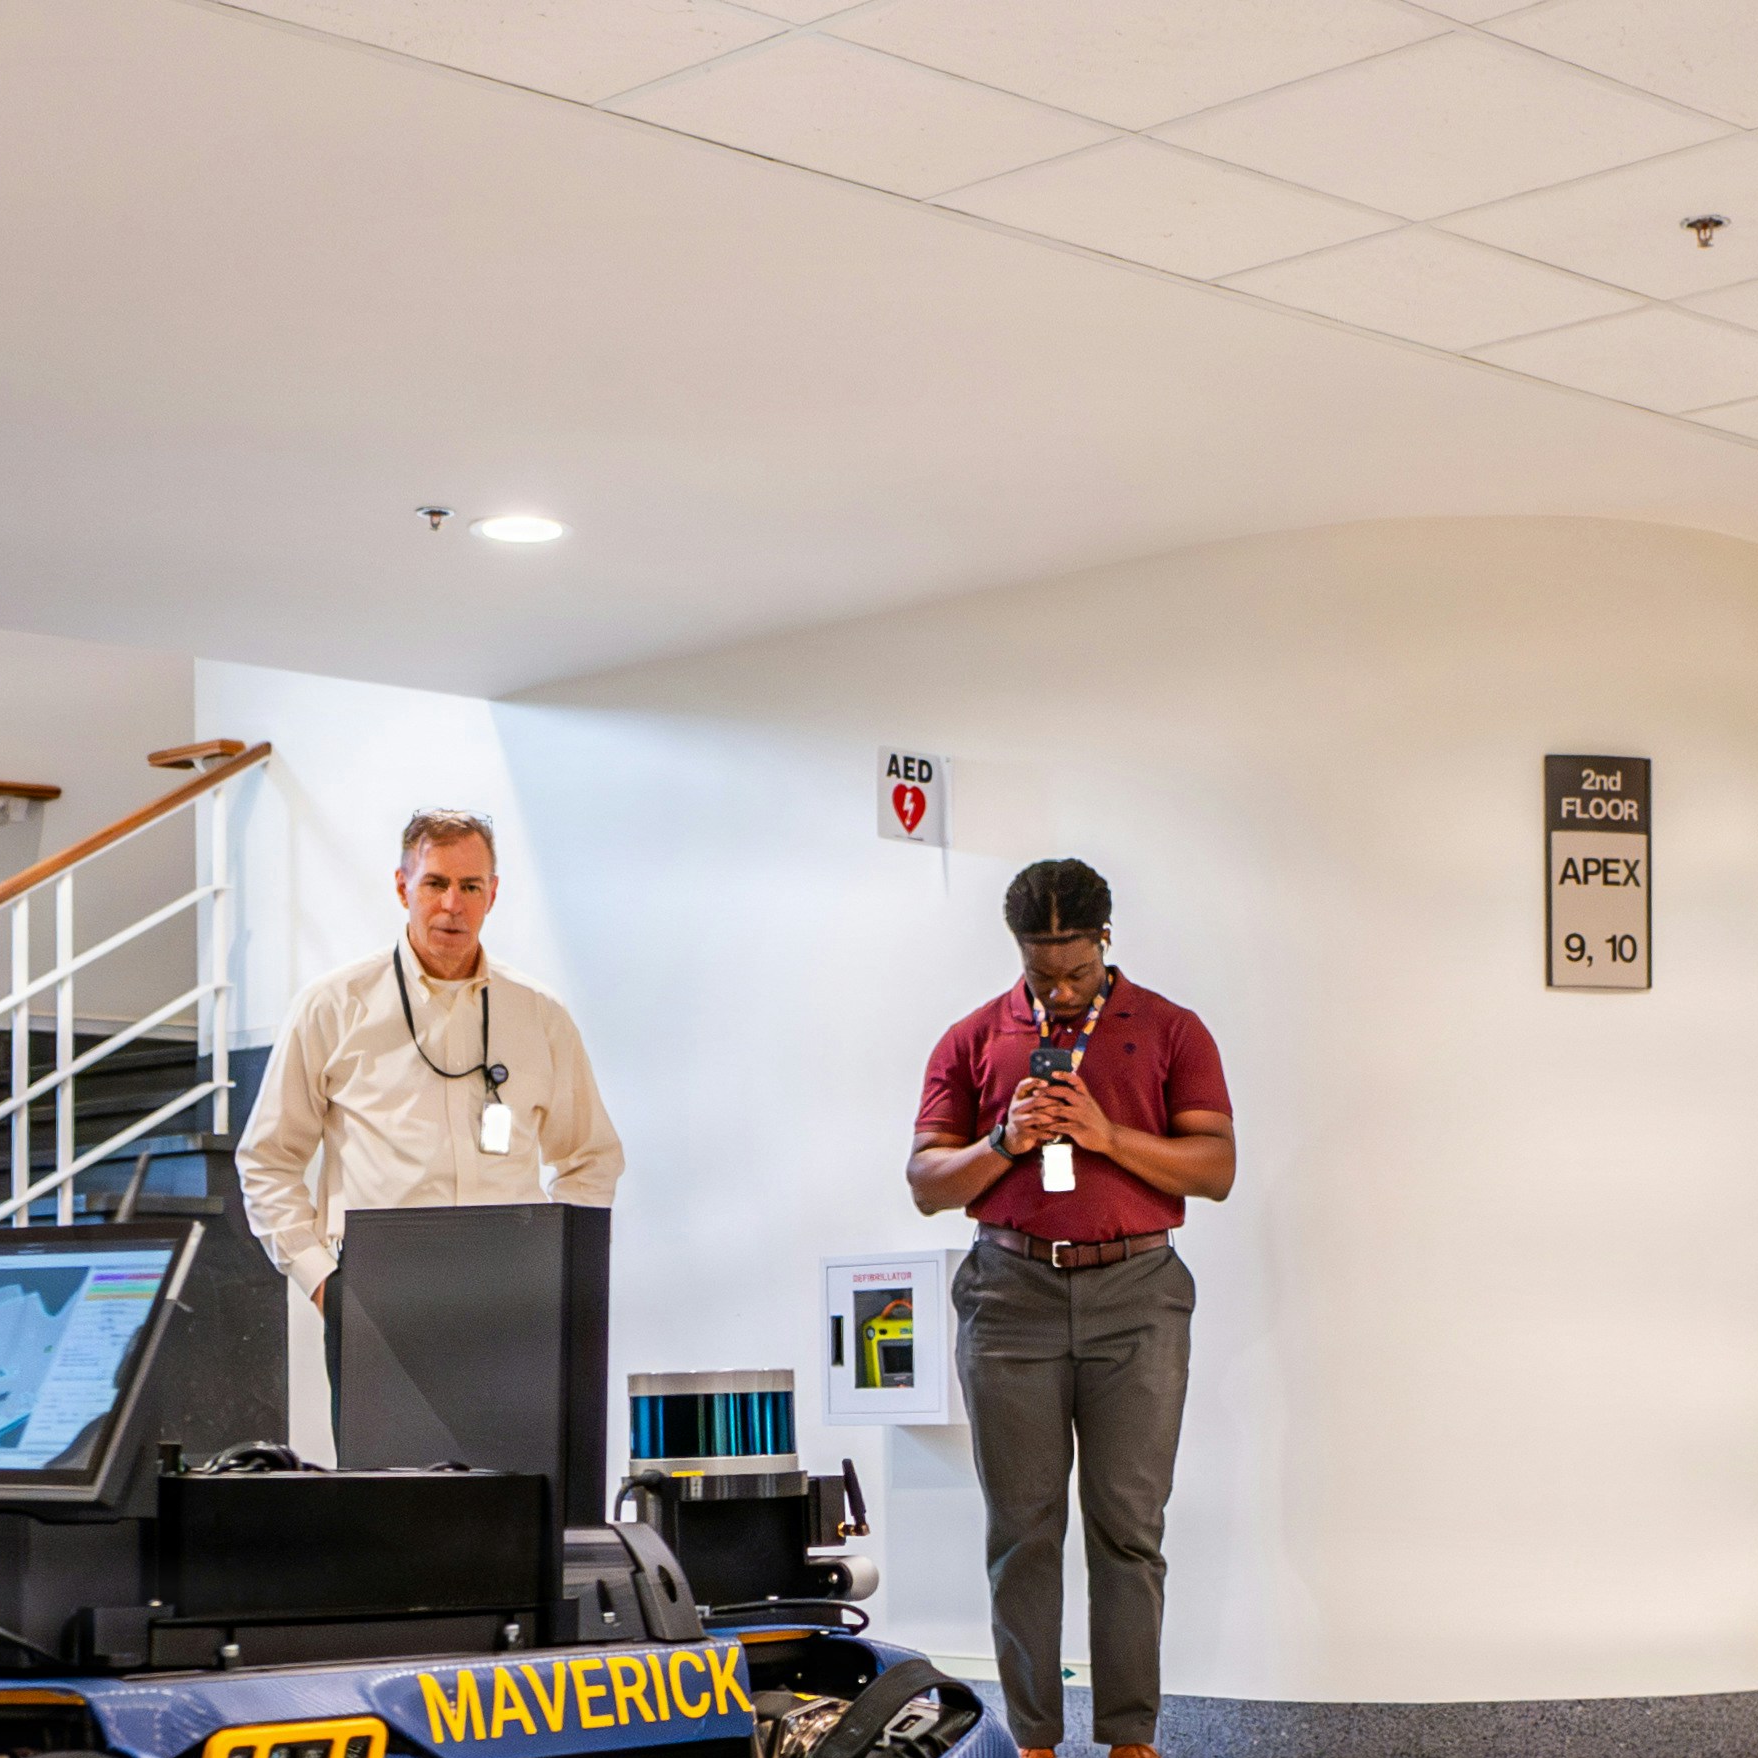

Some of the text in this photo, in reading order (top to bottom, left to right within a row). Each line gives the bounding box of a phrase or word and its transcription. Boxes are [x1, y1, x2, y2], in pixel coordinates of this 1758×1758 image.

[886, 753, 933, 784] AED
[1581, 769, 1622, 791] 2nd
[1561, 797, 1639, 821] FLOOR
[1559, 858, 1641, 887] APEX
[1564, 933, 1638, 967] 9, 10
[852, 1271, 912, 1282] DEFIBRILLATOR
[417, 1647, 753, 1744] MAVERICK
